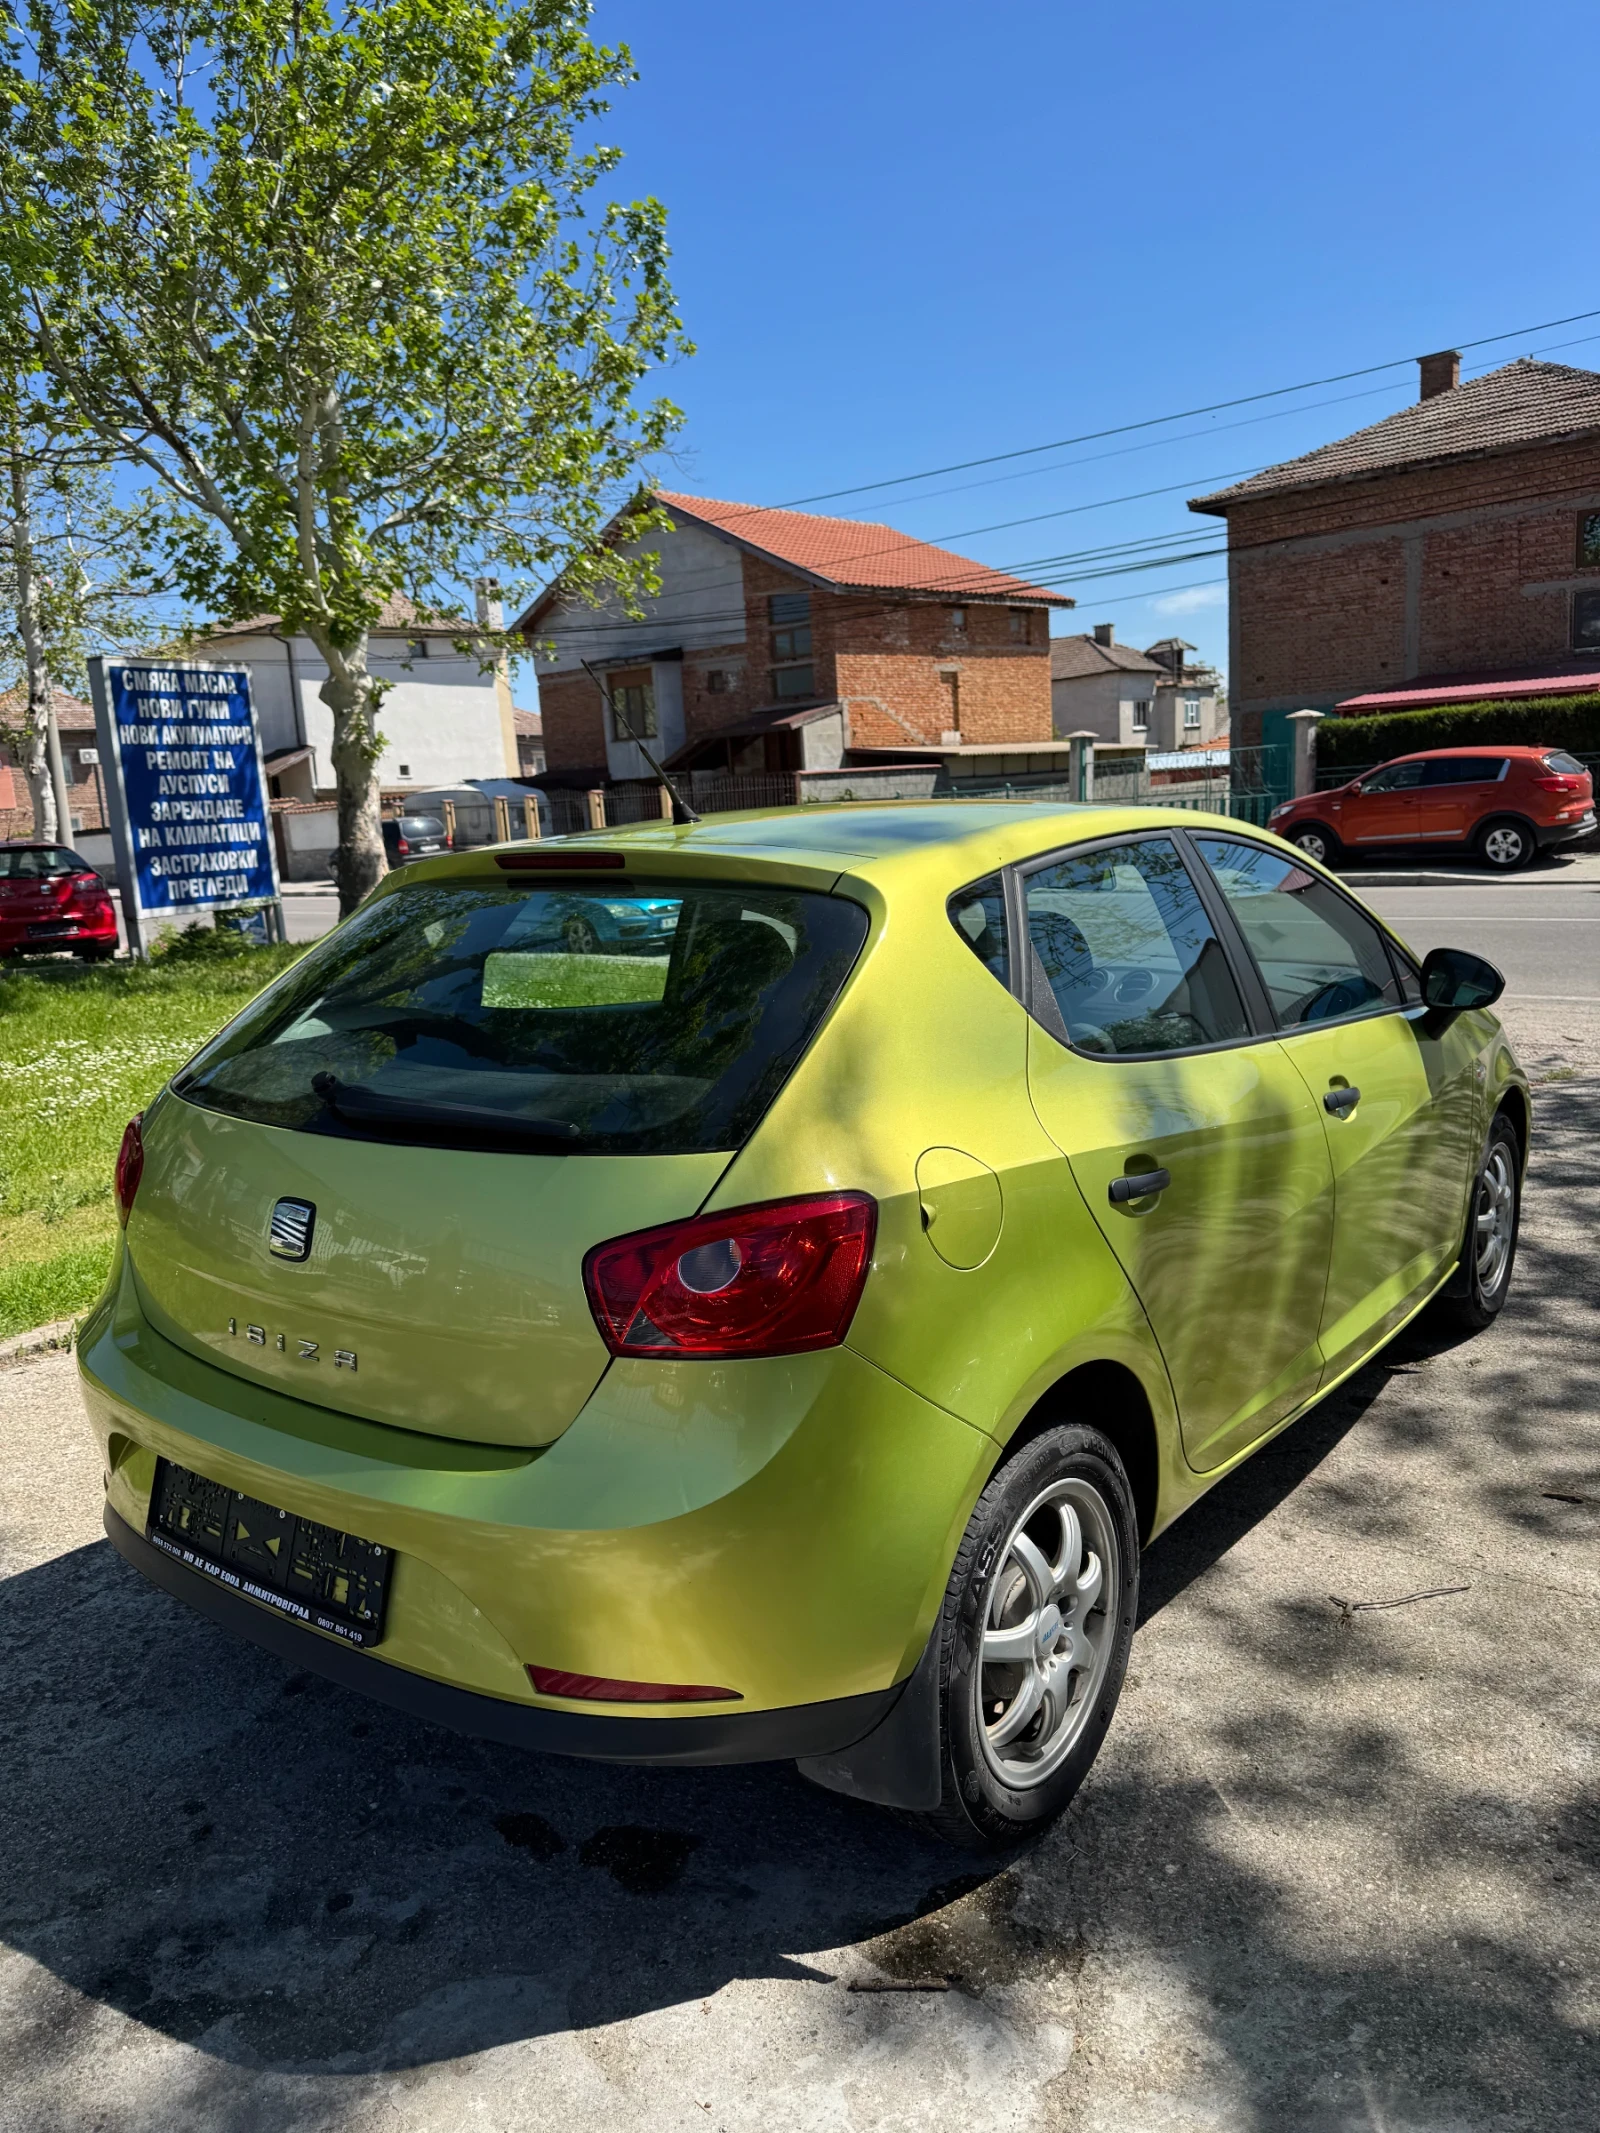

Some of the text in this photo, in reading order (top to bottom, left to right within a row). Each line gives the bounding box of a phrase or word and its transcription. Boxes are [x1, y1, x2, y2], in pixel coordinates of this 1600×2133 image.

[122, 669, 238, 695] СМЯНА МАСЛА
[137, 698, 230, 720] НОВИ ГУМИ
[119, 724, 253, 746] НОВИ АКУМУЛАТОРИ
[146, 751, 236, 770] РЕМОНТ НА
[158, 774, 230, 795] АУСПУСИ
[150, 800, 245, 824] ЗАРЕЖДАНЕ
[138, 822, 261, 849] НА КЛИМАТИЦИ
[150, 849, 259, 877] ЗАСТРАХОВКИ
[168, 874, 249, 901] ПРЕГЛЕДИ
[228, 1317, 358, 1372] IBIZA
[204, 1561, 220, 1576] КАР
[220, 1569, 240, 1588] ЕООД
[242, 1581, 310, 1620] ДИМИТРОВГРАД
[335, 1624, 348, 1636] 861
[349, 1631, 363, 1642] 419
